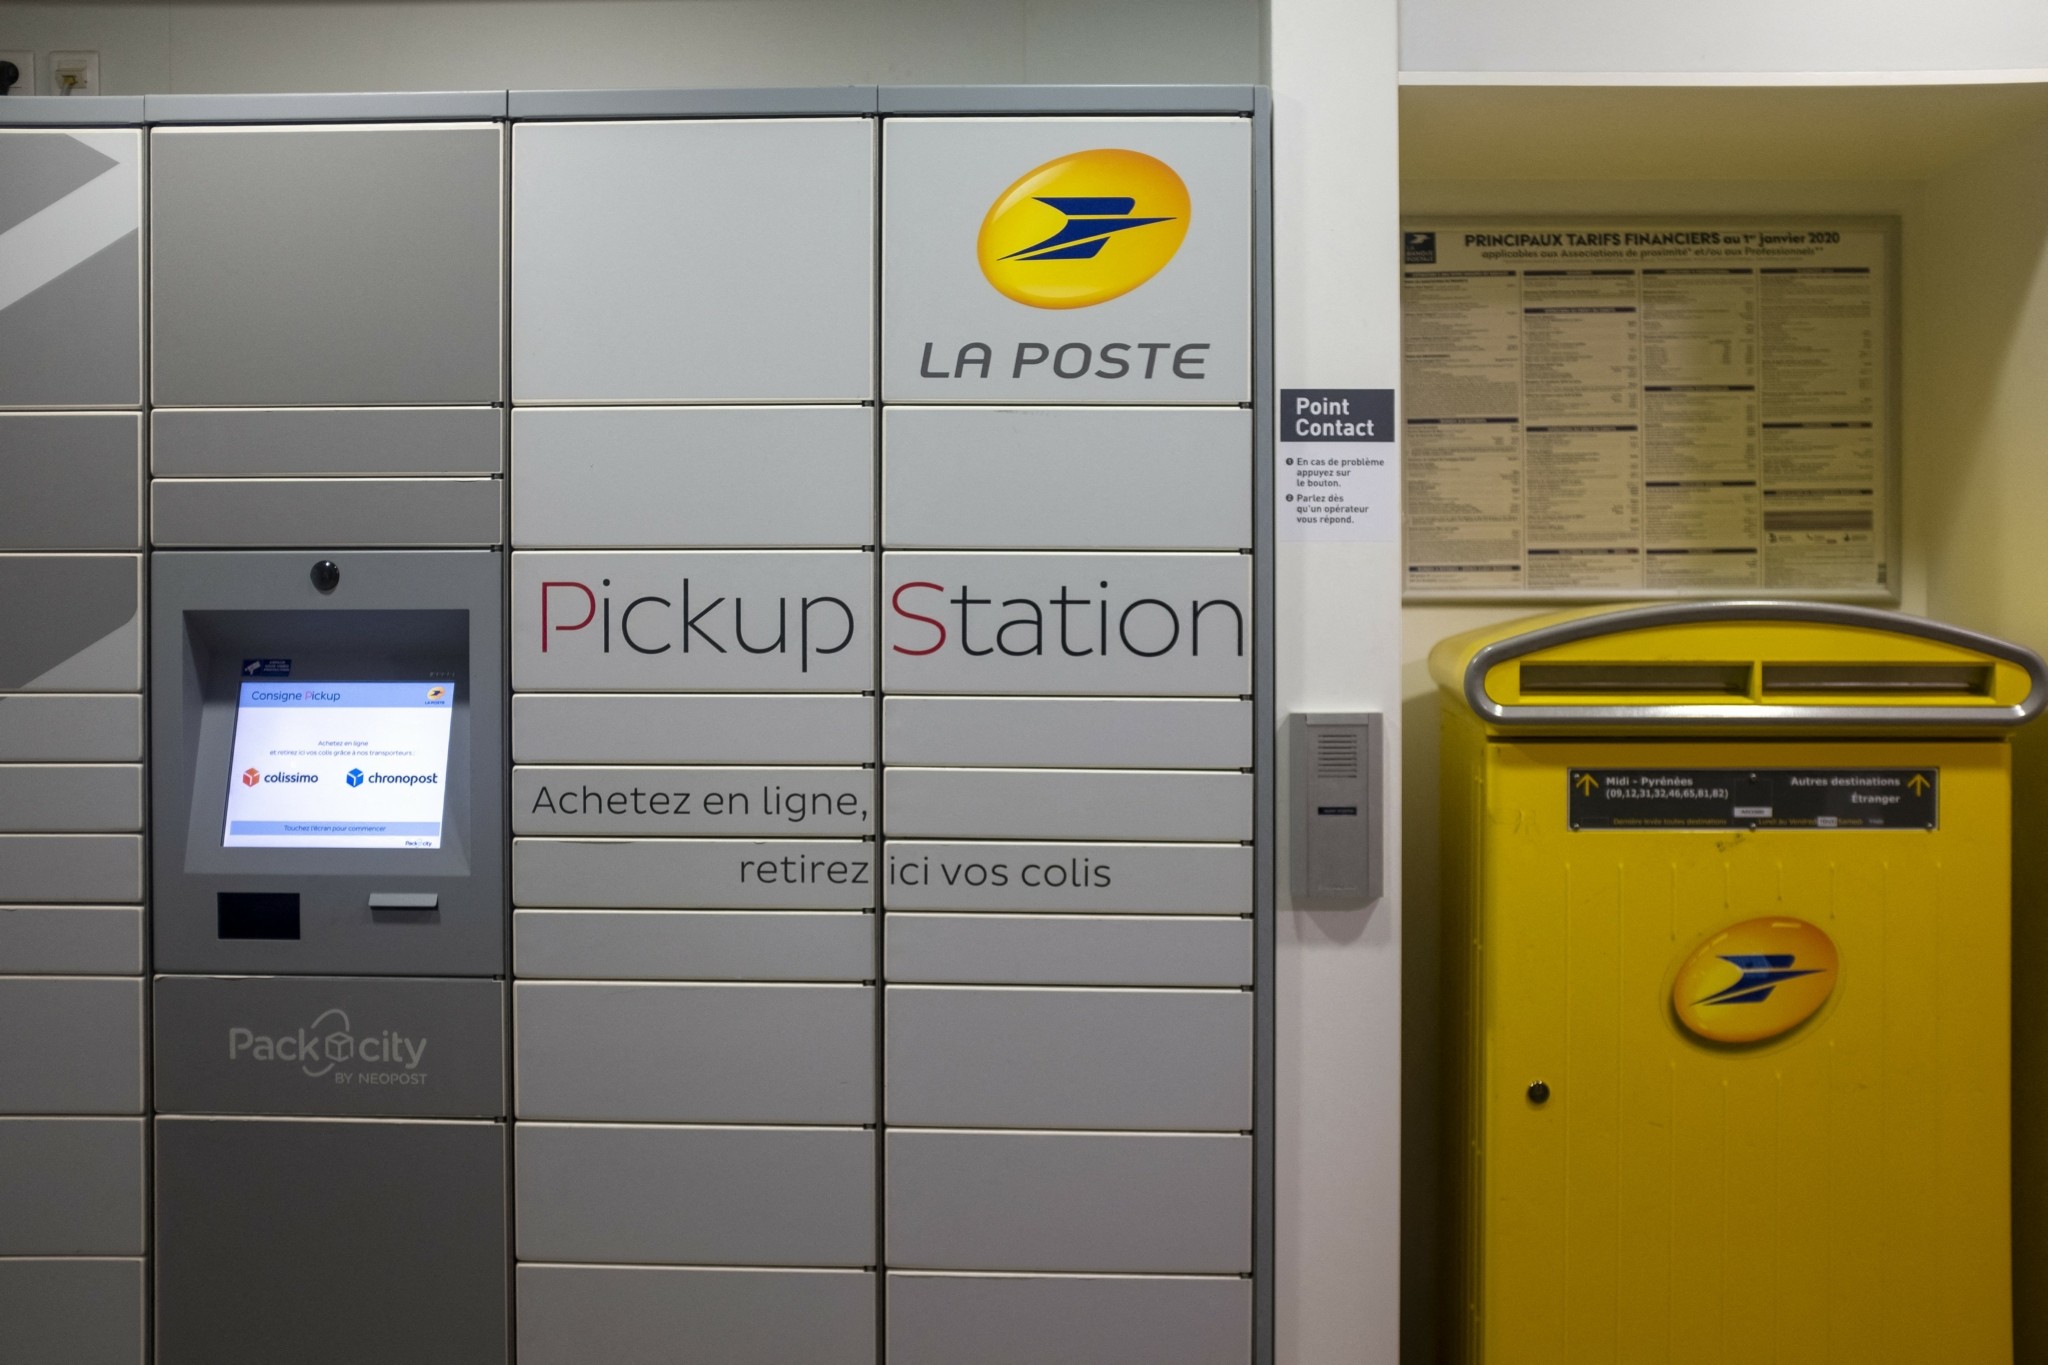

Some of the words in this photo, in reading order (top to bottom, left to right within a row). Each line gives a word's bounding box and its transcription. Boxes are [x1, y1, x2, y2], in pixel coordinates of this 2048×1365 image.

[1465, 233, 1562, 247] PRINCIPAUX
[1567, 232, 1621, 247] TARIFS
[1624, 231, 1721, 246] FINANCIERS
[1723, 235, 1741, 245] au
[1758, 232, 1805, 246] janvier
[1808, 231, 1841, 244] 2020
[1482, 248, 1538, 260] applicables
[1541, 250, 1559, 258] aux
[1561, 247, 1623, 259] Associations
[1625, 247, 1638, 258] de
[1694, 246, 1722, 257] et/ou
[920, 342, 992, 379] LA
[1013, 342, 1211, 380] POSTE
[1296, 397, 1350, 415] Point
[1296, 418, 1375, 436] Contact
[1297, 458, 1308, 466] En
[1328, 458, 1339, 466] de
[1341, 457, 1385, 469] problème
[1297, 469, 1333, 478] appuyez
[1297, 479, 1305, 487] le
[1307, 479, 1342, 487] bouton.
[1297, 494, 1326, 502] Parlez
[1328, 493, 1344, 502] dès
[1297, 505, 1322, 514] qu'un
[1324, 504, 1369, 514] opérateur
[1320, 515, 1355, 525] répond.
[542, 578, 854, 673] Pickup
[891, 580, 1245, 657] Station
[251, 690, 302, 702] Consigne
[305, 690, 341, 702] Pickup
[353, 740, 369, 748] ligne
[333, 750, 351, 758] grâce
[264, 772, 318, 784] colissimo
[368, 772, 438, 786] chronopost
[1606, 777, 1630, 786] Midi
[1641, 776, 1693, 788] Pyrénées
[1790, 777, 1828, 786] Autres
[1830, 776, 1901, 786] destinations
[1606, 788, 1729, 801] (09,12,31,32,46,65,81,82)
[1851, 792, 1901, 804] Étranger
[532, 785, 691, 815] Achetez
[703, 794, 750, 815] en
[763, 785, 868, 823] ligne,
[284, 824, 309, 832] Touchez
[740, 855, 870, 886] retirez
[890, 856, 930, 886] ici
[942, 863, 1009, 887] vos
[1021, 857, 1112, 888] colis
[229, 1027, 319, 1063] Pack
[359, 1030, 428, 1071] city
[335, 1072, 353, 1085] BY
[358, 1072, 427, 1086] NEOPOST
